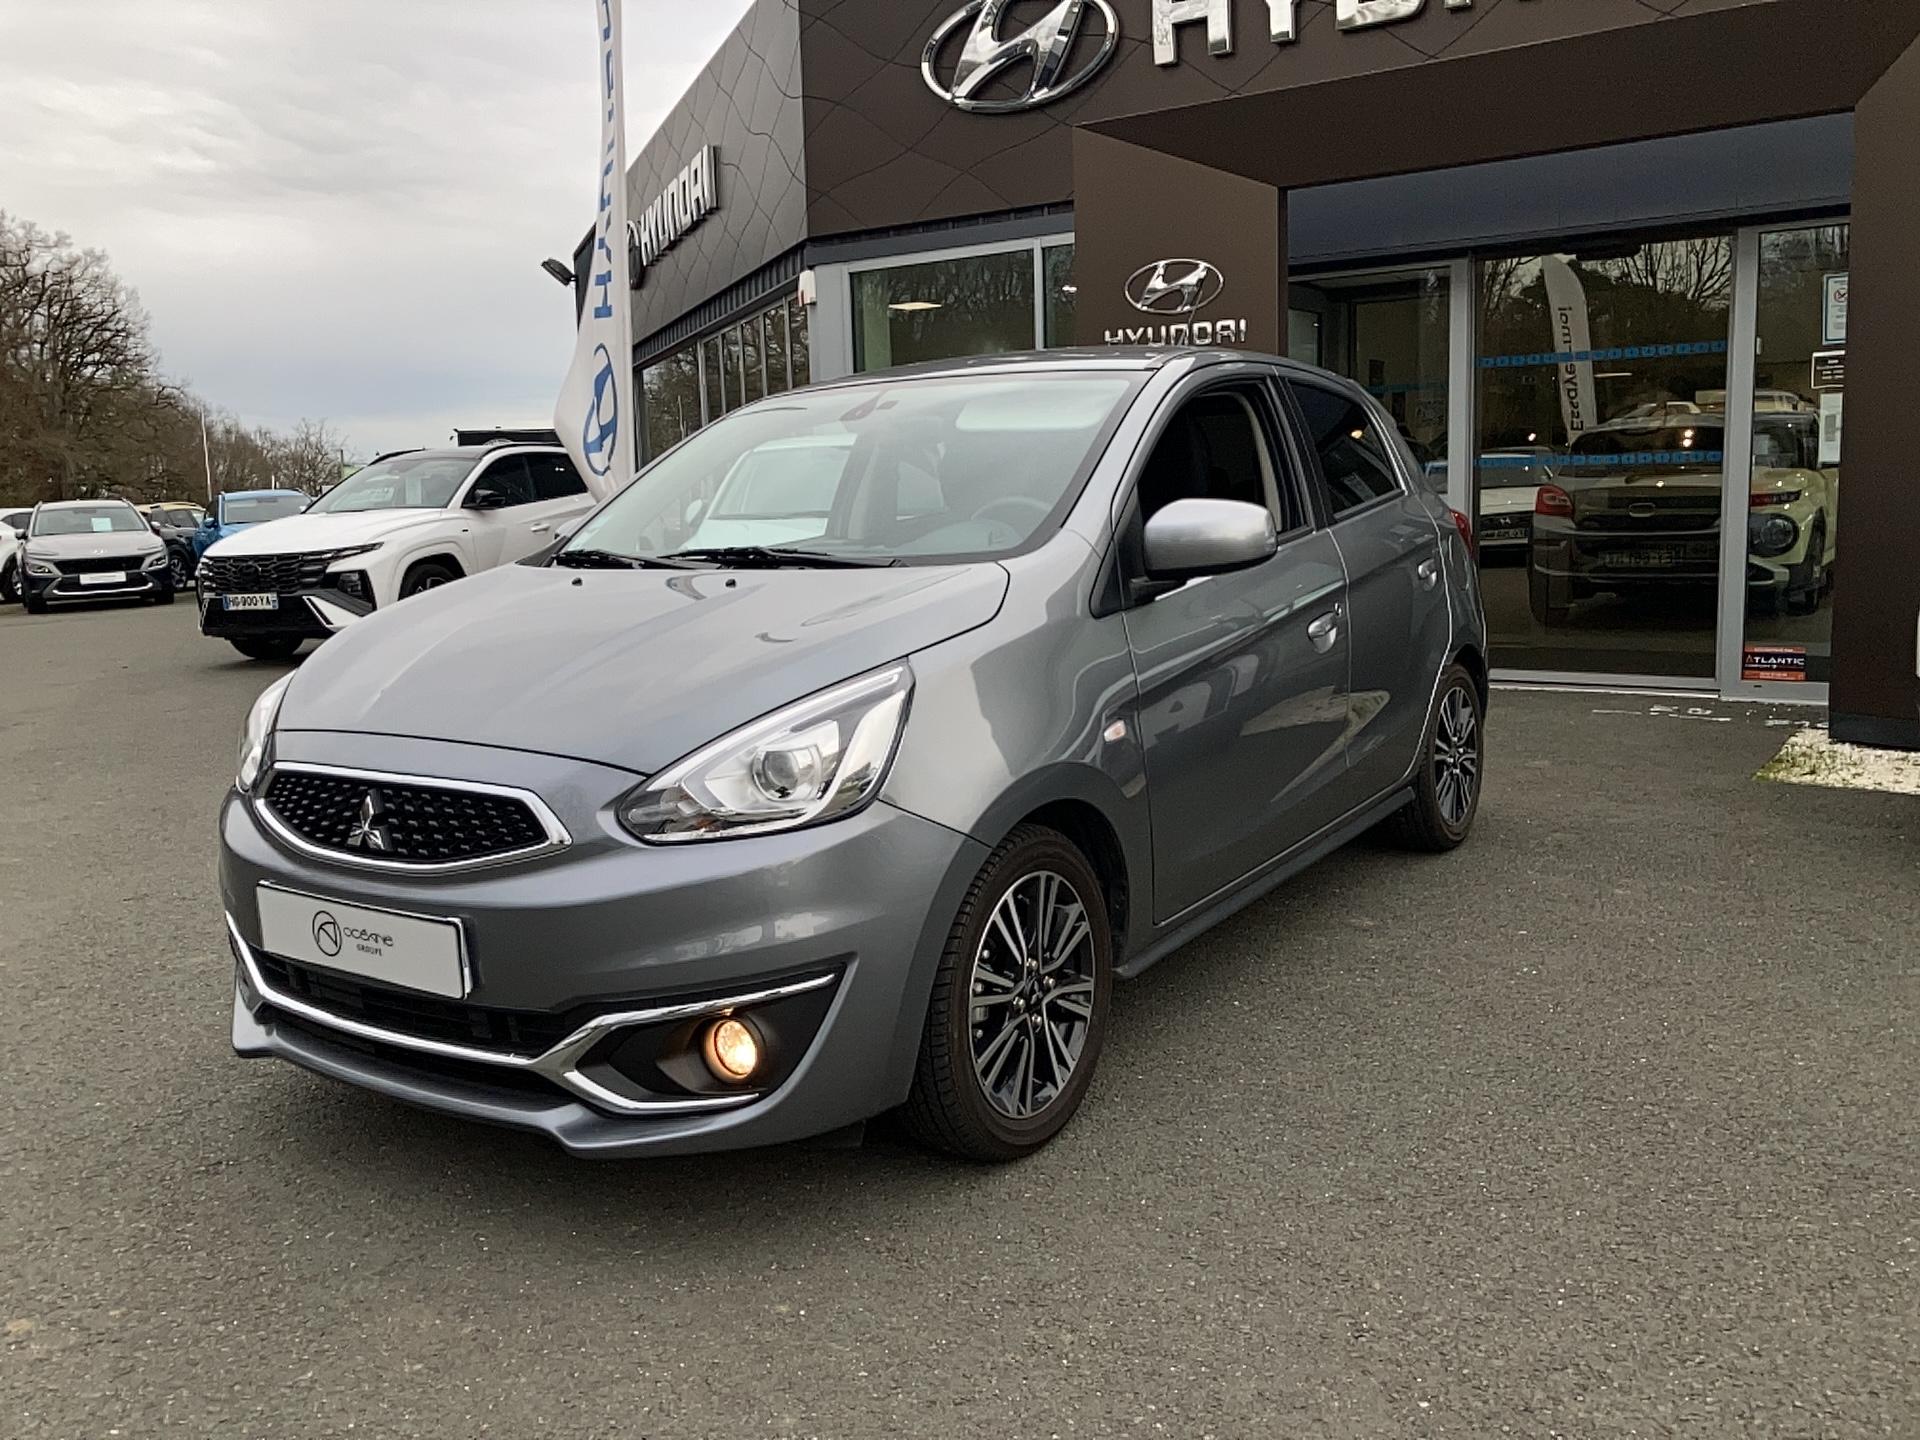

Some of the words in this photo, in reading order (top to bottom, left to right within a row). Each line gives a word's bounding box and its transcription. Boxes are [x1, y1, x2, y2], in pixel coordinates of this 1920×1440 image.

[640, 143, 720, 268] HYUNDAI
[1103, 318, 1248, 348] HYUNDAI
[1745, 654, 1805, 666] ATLANTIC
